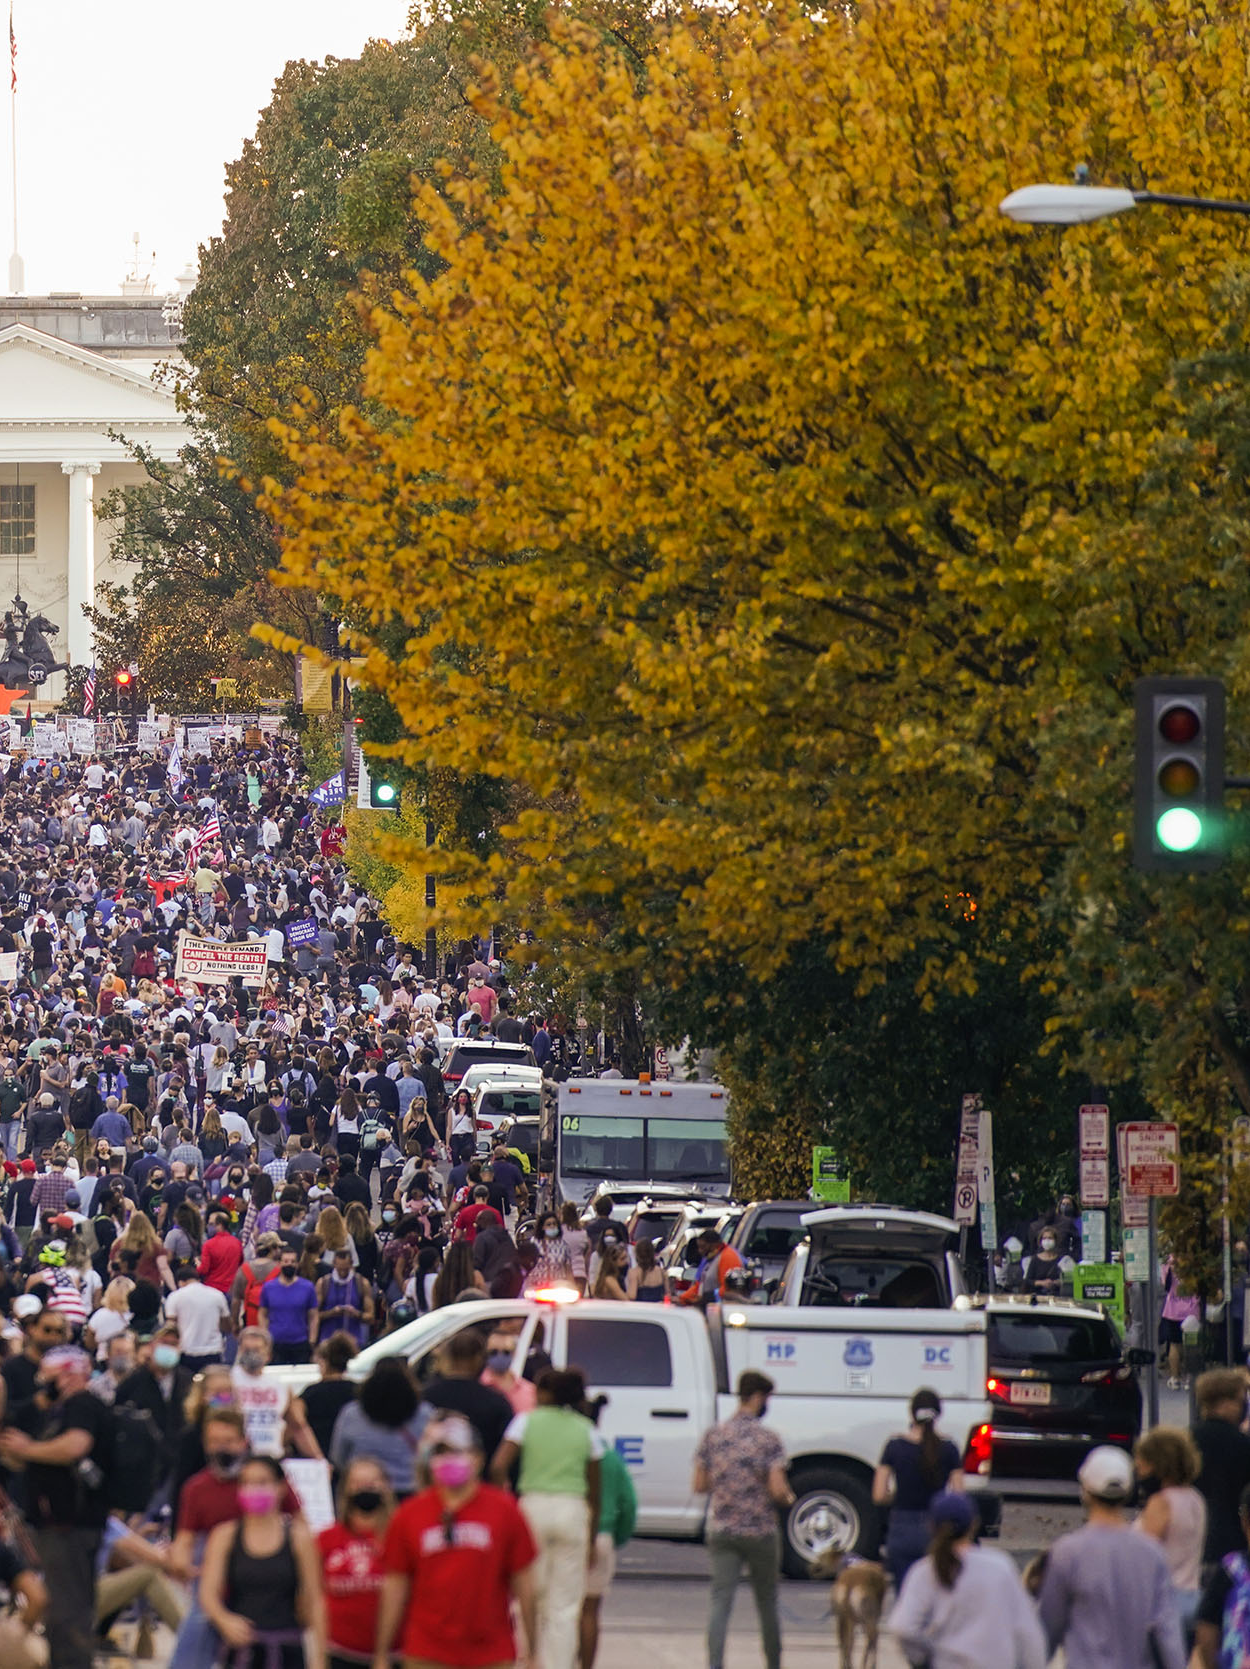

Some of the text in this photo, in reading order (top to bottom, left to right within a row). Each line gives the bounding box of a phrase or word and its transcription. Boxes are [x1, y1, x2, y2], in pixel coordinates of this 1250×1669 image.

[289, 927, 315, 938] DEMOCRACY
[291, 923, 310, 932] PROTECT
[184, 950, 264, 963] CANCEL THE RENTS!
[206, 962, 236, 970] NOTHING
[562, 1116, 579, 1130] 06
[1138, 1132, 1164, 1142] SNOW
[766, 1344, 796, 1359] MP
[924, 1348, 951, 1363] DC
